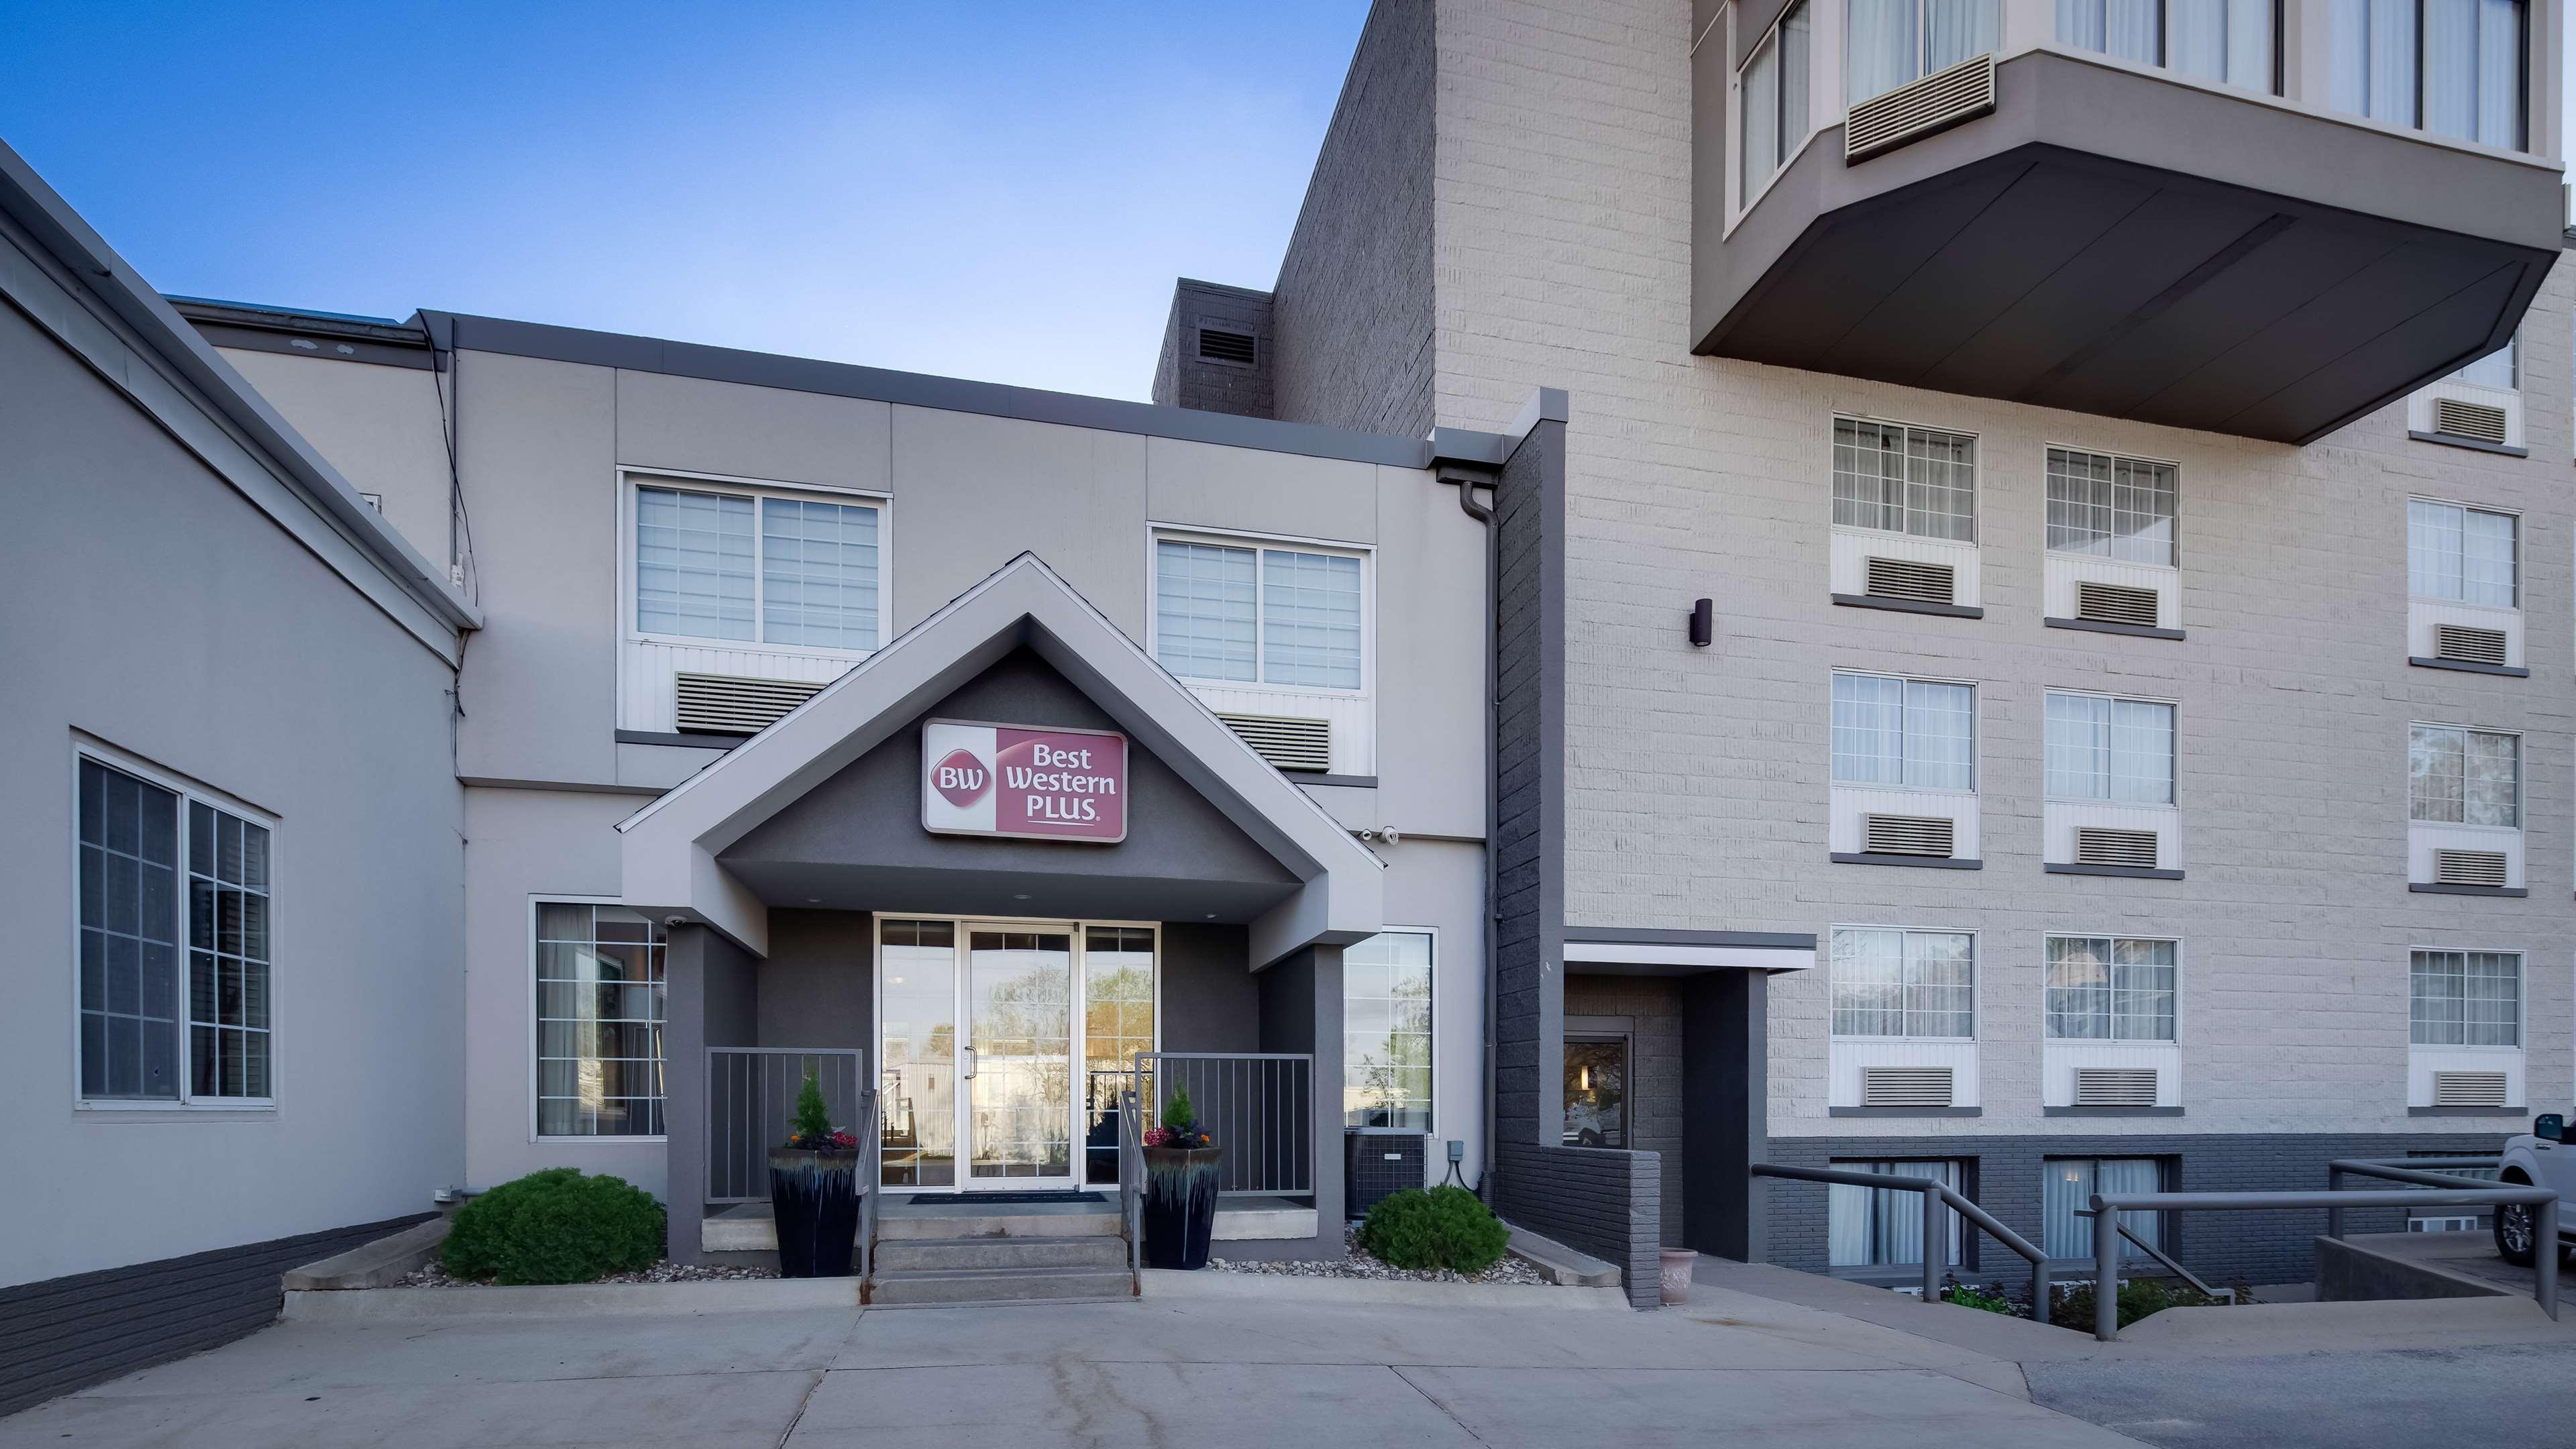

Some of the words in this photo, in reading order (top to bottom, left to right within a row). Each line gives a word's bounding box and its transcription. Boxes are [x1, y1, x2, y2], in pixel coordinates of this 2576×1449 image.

[1034, 744, 1092, 769] Best
[940, 767, 983, 790] BW
[1006, 766, 1116, 795] Western
[1027, 795, 1095, 820] PLUS
